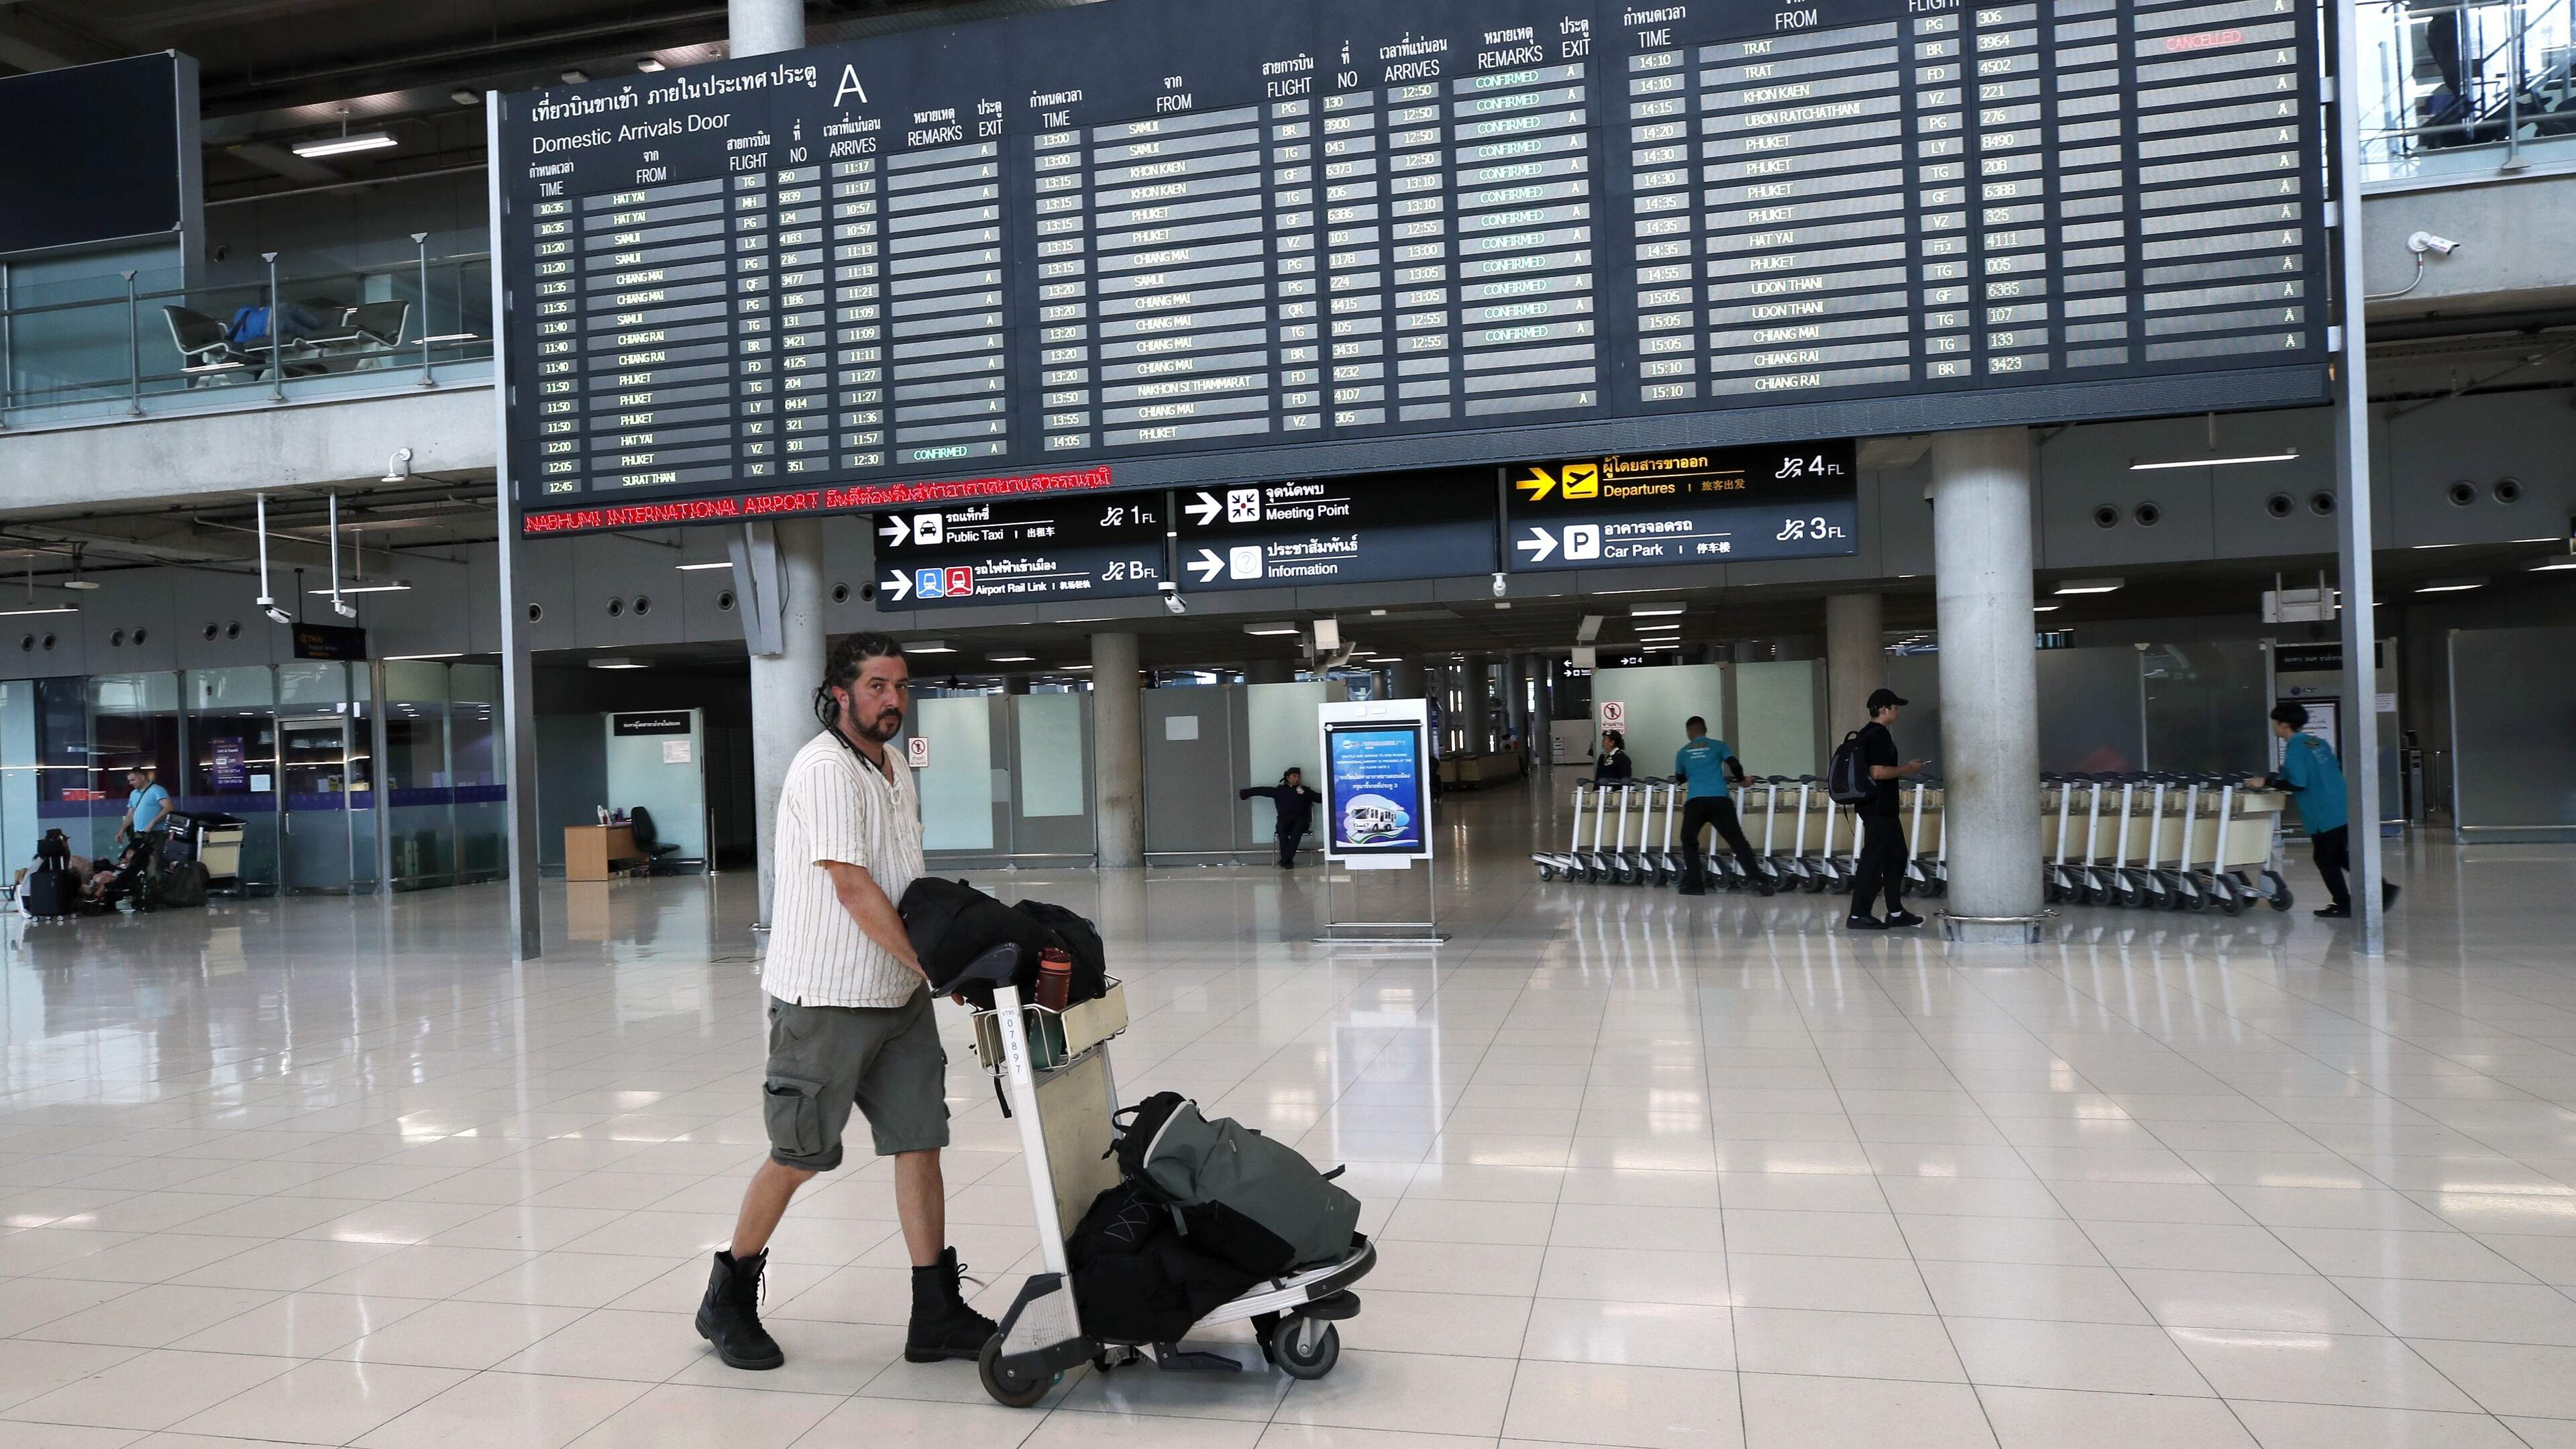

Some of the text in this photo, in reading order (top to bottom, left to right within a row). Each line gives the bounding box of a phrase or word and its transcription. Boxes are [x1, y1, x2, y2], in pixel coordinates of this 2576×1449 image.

[1775, 9, 1817, 30] FROM
[1562, 38, 1591, 58] EXIT
[1638, 29, 1671, 48] TIME
[1640, 11, 2002, 68] 14:10 TRAT PG 306
[2166, 31, 2242, 52] CANCELLED
[1478, 46, 1543, 70] REMARKS
[1338, 71, 1358, 89] NO
[1385, 60, 1440, 83] ARRIVES
[833, 64, 868, 107] A
[1268, 77, 1311, 98] FLIGHT
[1043, 70, 1538, 146] 13:00 SAMUI PG 130 12:50 CONFIRMED
[1157, 93, 1192, 113] FROM
[1643, 85, 2004, 138] 14:20 UBON RATCHATHANI VZ 221
[979, 119, 1003, 137] EXIT
[1042, 110, 1071, 128] TIME
[533, 111, 731, 154] Domestic Arrivals Door
[908, 125, 963, 147] REMARKS
[790, 147, 807, 162] NO
[830, 138, 876, 157] ARRIVES
[1044, 117, 1540, 189] 13:15 KHON KAEN TG 043 12:50 CONFIRMED
[730, 153, 767, 171] FLIGHT
[541, 203, 564, 215] 10:35
[742, 177, 755, 187] TG
[778, 171, 795, 182] 260
[845, 162, 869, 173] 11:17
[981, 146, 987, 155] A
[636, 166, 666, 184] FROM
[540, 180, 564, 197] TIME
[1647, 209, 2008, 256] 14:35 HAT YAI VZ 325
[543, 283, 566, 294] 11:35
[745, 259, 758, 269] PG
[781, 254, 798, 265] 216
[847, 246, 871, 257] 11:13
[1049, 256, 1546, 318] 13:20 CHIANG MAI PG 224 13:05 CONFIRMED
[1649, 264, 1951, 303] 15:05 UDON THANI TG
[546, 350, 875, 393] 11:50 PHUKET FD 4125 11:11
[1652, 334, 2295, 398] 15:10 CHIANG RAI BR 3423 A
[1052, 376, 1251, 404] 13:50 NAKHON SI THAMMARAT
[1053, 413, 1355, 447] 14:05 PHUKET VZ 305
[549, 482, 573, 492] 12:45
[751, 464, 764, 474] VZ
[788, 462, 804, 472] 351
[854, 455, 878, 466] 12:30
[914, 446, 967, 461] CONFIRMED
[991, 444, 998, 453] A
[1808, 455, 1844, 476] 4 FL
[1266, 482, 1324, 502] จุดนัดพบ
[1604, 482, 1675, 499] Departures
[1701, 478, 1745, 492] 旅客出发
[607, 498, 739, 526] INTERNATIONAL
[745, 492, 819, 514] AIRPORT
[1131, 506, 1156, 524] 1 FL
[1266, 503, 1349, 521] Meeting Point
[947, 529, 1004, 543] Public Taxi
[1027, 527, 1055, 538] 出租车
[1811, 517, 1845, 539] 3 FL
[1604, 543, 1663, 559] Car Park
[1130, 561, 1158, 579] B FL
[1268, 563, 1338, 578] Information
[975, 581, 1046, 596] Airport Rail Link
